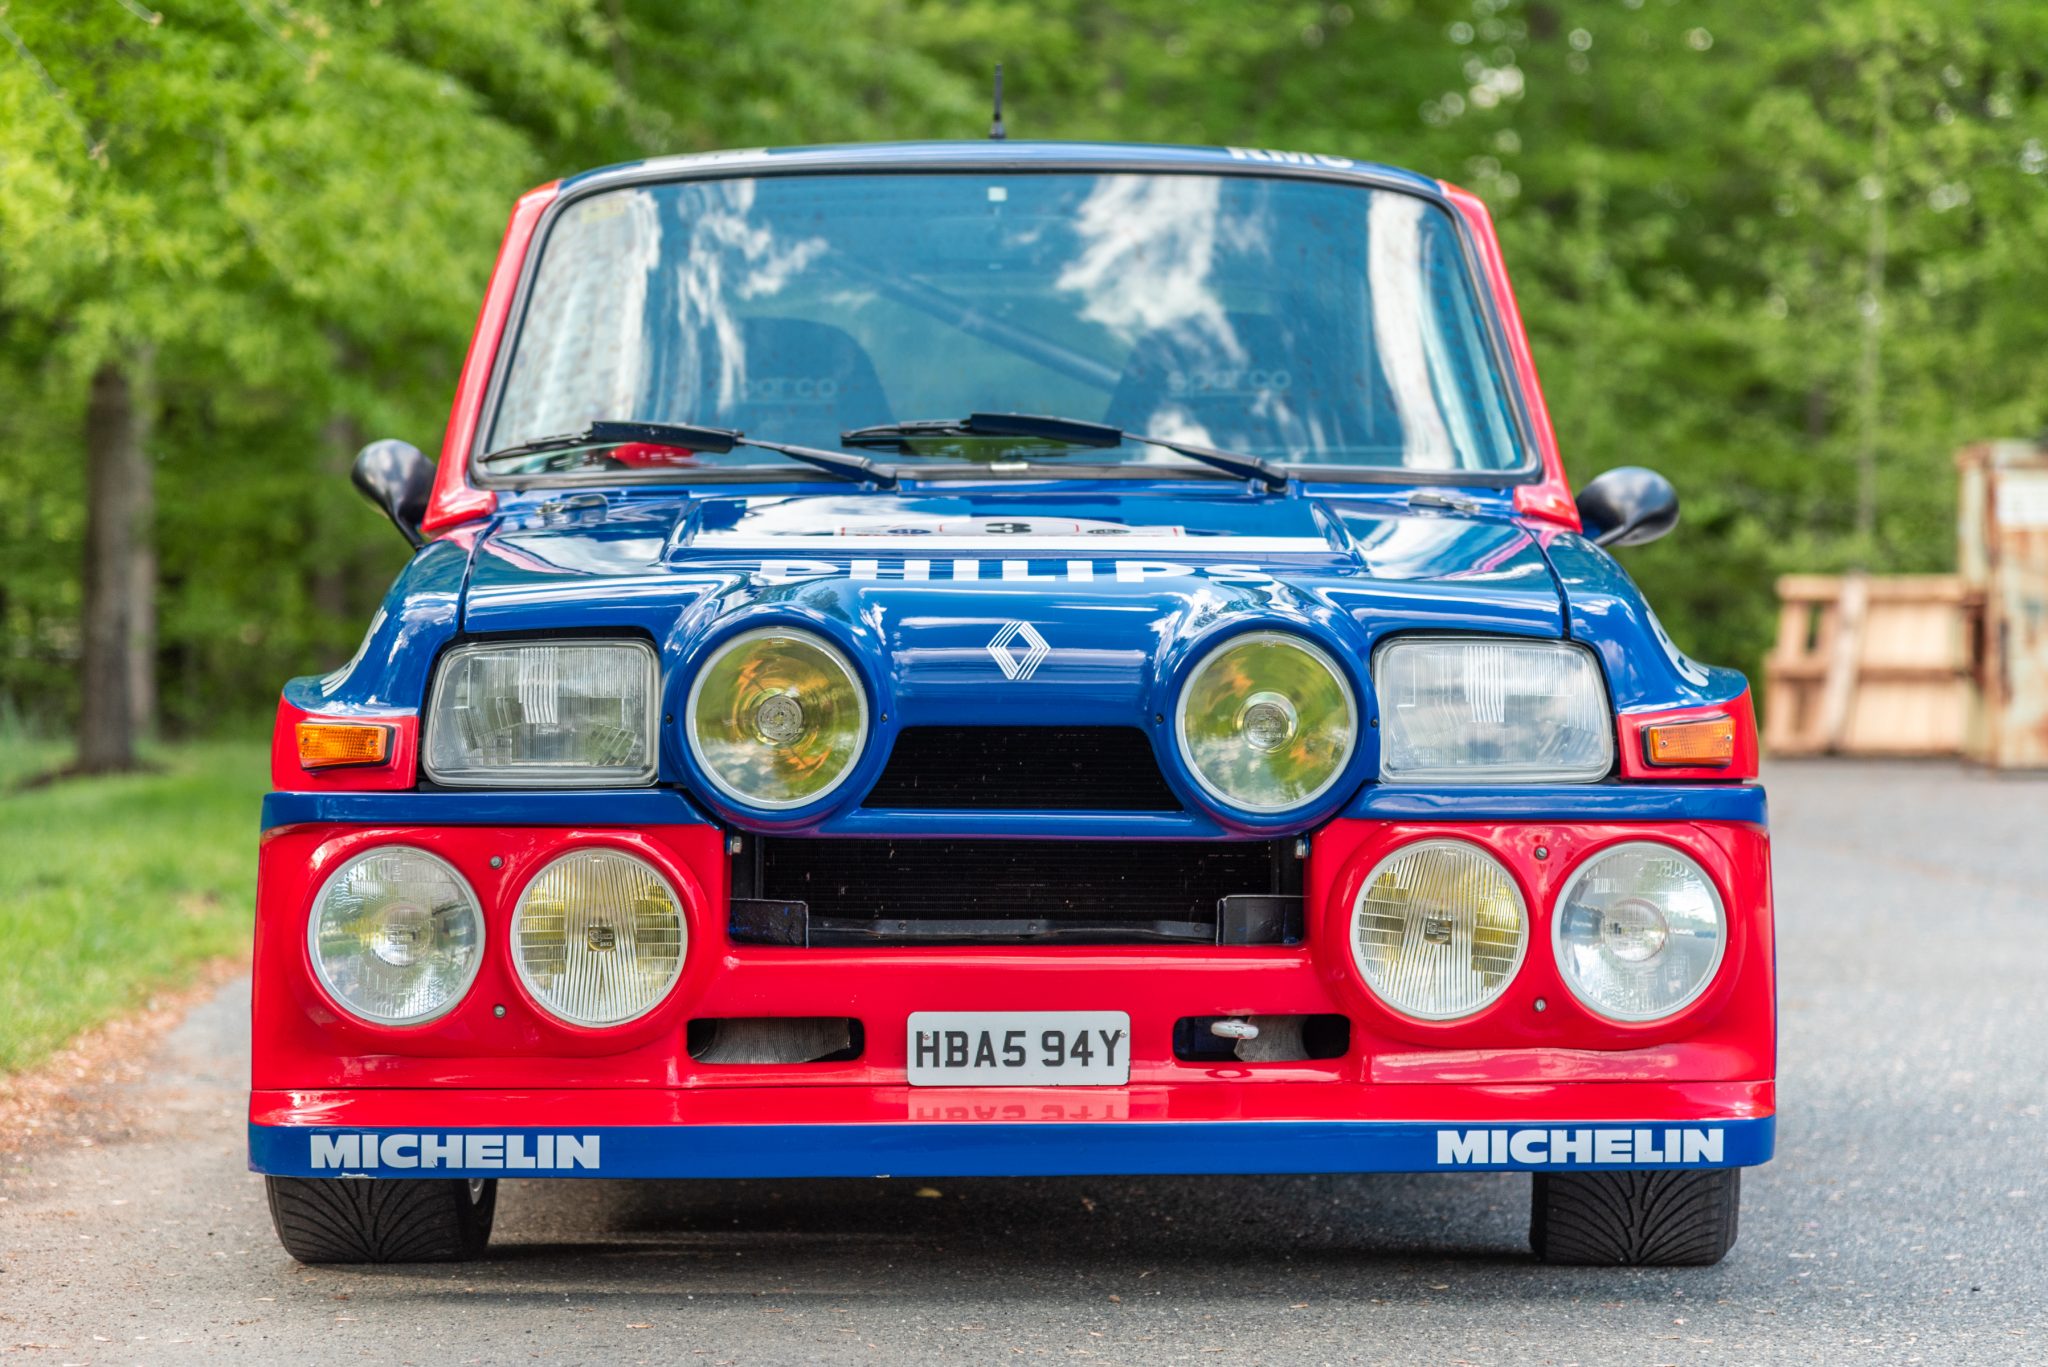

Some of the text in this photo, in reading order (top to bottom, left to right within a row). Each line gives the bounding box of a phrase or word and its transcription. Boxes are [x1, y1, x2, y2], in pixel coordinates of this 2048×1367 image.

[759, 559, 1275, 583] PHILIPS
[915, 1030, 1124, 1068] HBA5 94Y
[309, 1133, 601, 1169] MICHELIN
[1436, 1128, 1725, 1164] MICHELIN
